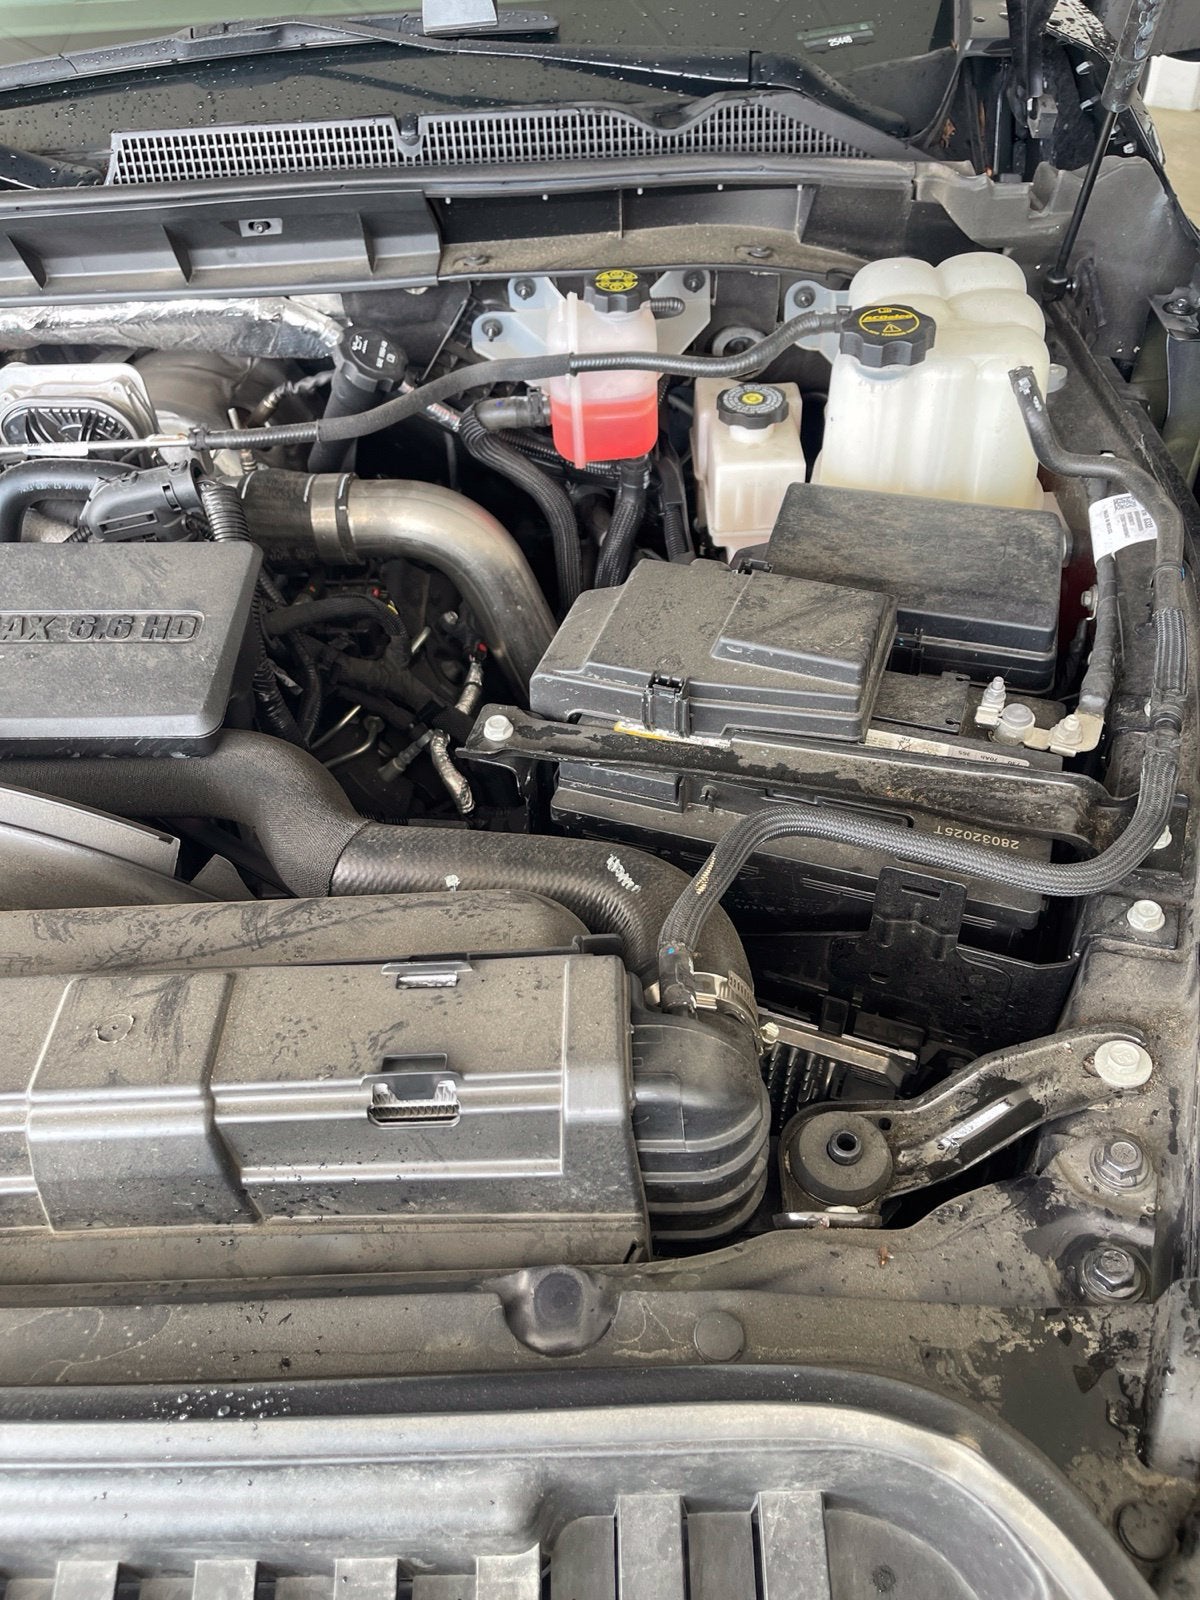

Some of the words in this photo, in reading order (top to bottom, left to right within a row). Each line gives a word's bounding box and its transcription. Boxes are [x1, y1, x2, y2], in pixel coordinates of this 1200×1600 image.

[0, 615, 56, 641] AX
[68, 615, 135, 641] 6.6
[141, 615, 198, 640] HD
[933, 825, 1020, 850] 28032025T
